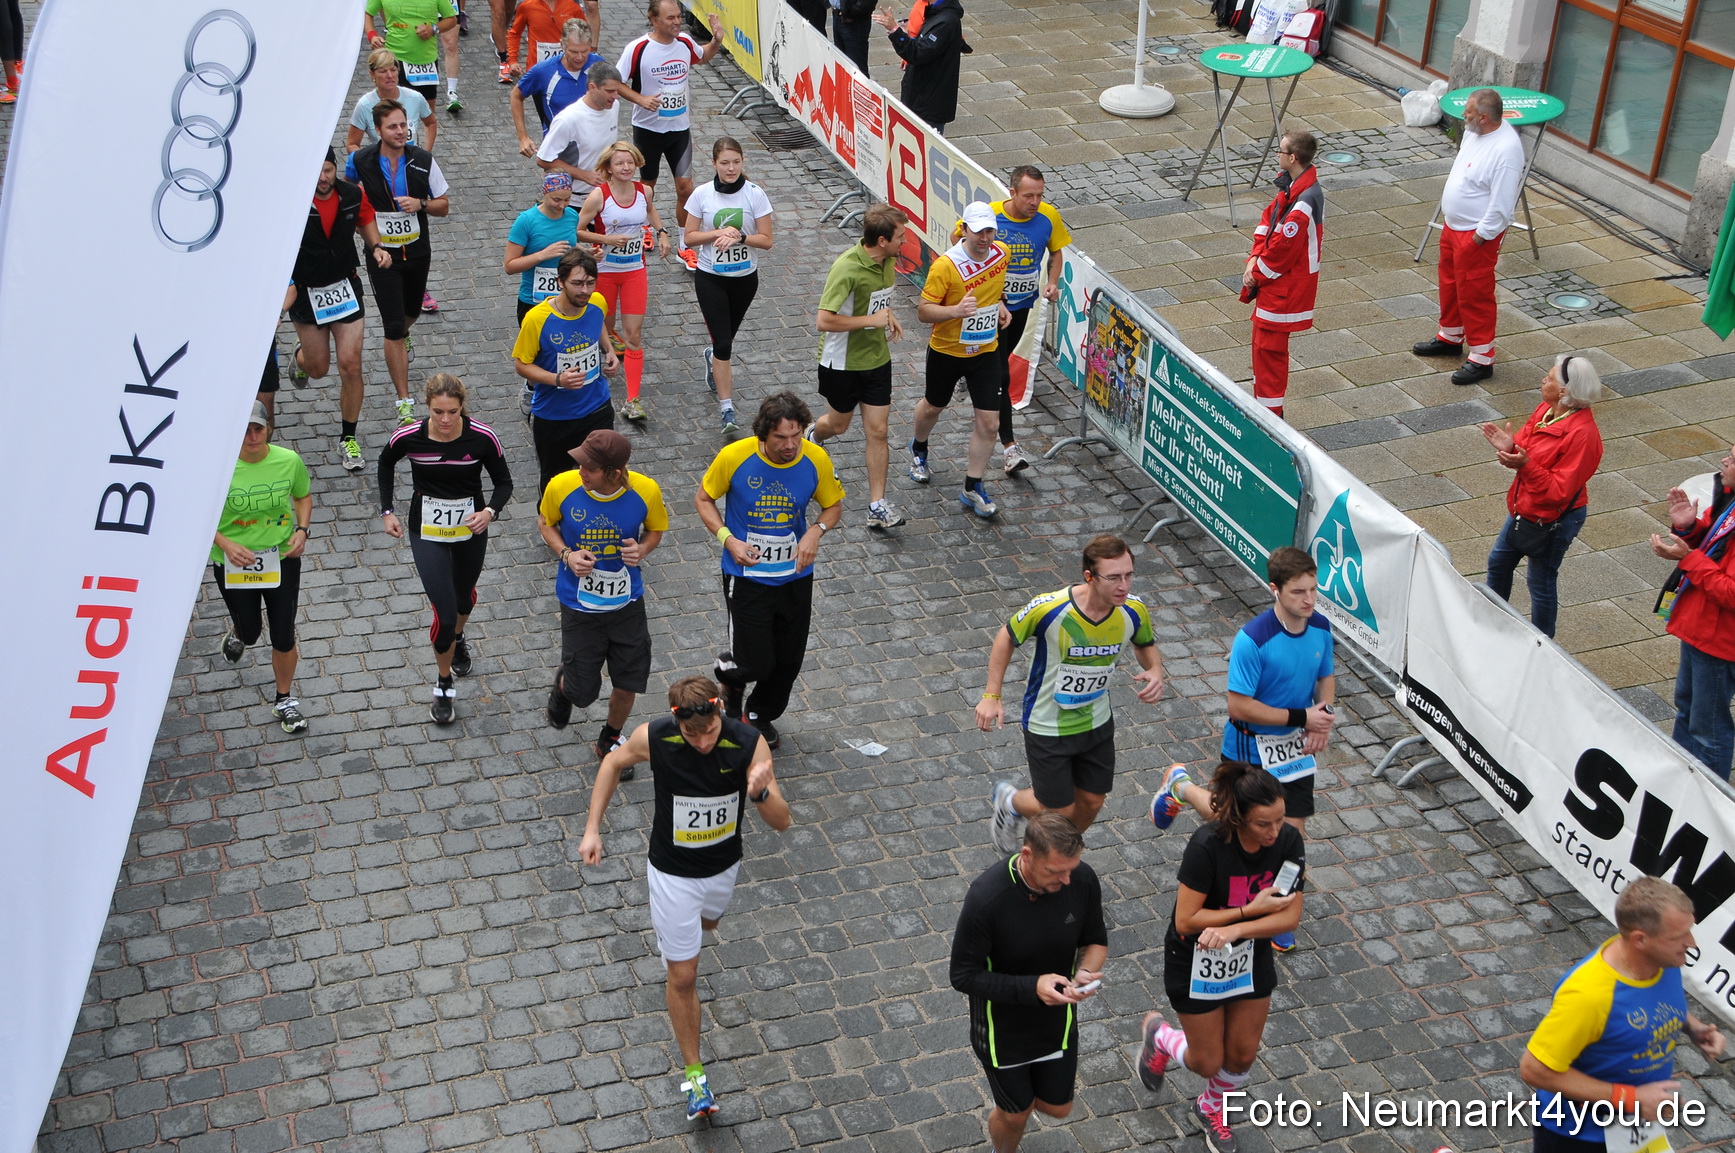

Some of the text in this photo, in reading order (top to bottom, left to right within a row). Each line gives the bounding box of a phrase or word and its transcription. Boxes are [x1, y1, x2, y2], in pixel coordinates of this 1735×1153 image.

[651, 63, 682, 73] GERHART
[666, 68, 686, 77] JANIG
[835, 111, 854, 151] Braun
[385, 220, 412, 235] 338
[715, 246, 748, 263] 2156
[964, 276, 988, 292] MAX
[1003, 280, 1036, 293] 2865
[314, 286, 351, 309] 2834
[325, 303, 349, 316] Michael
[966, 313, 997, 331] 2625
[1173, 373, 1242, 440] Event-Leit-Systeme
[1152, 394, 1243, 490] Mehr Sicherheit
[1149, 419, 1225, 503] für Ihr Event!
[432, 508, 465, 526] 217
[1147, 455, 1257, 565] Miet & Service Line: 09181 6352
[45, 333, 190, 799] Audi BKK
[243, 574, 263, 582] Petra
[583, 576, 627, 596] 3412
[1333, 607, 1357, 632] Service
[1358, 626, 1379, 649] GmbH
[1068, 643, 1122, 658] BOCK
[1060, 675, 1108, 693] 2879
[1454, 731, 1468, 752] die
[1469, 746, 1518, 802] verbinden
[698, 800, 730, 808] Neumarkt
[687, 807, 727, 828] 218
[686, 828, 726, 841] Sebastian
[1563, 747, 1735, 956] SW
[1199, 953, 1248, 980] 3392
[1203, 979, 1237, 993] Kerstin
